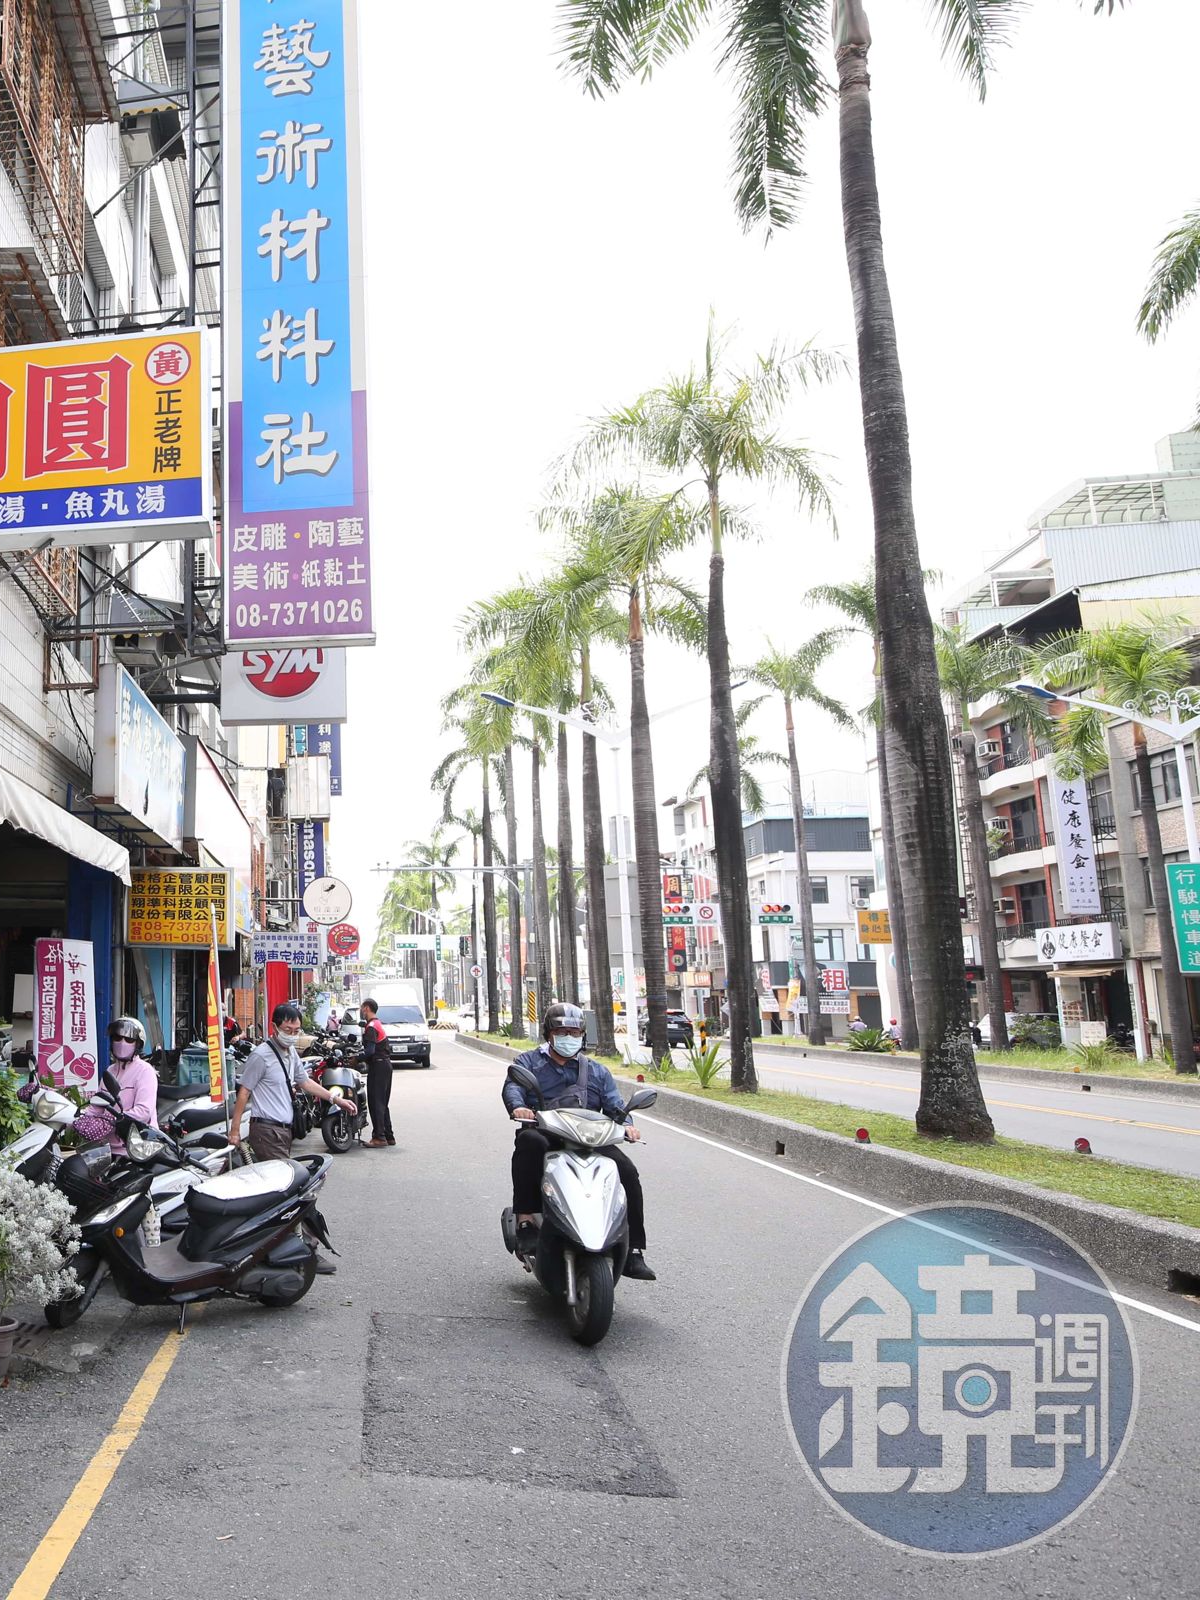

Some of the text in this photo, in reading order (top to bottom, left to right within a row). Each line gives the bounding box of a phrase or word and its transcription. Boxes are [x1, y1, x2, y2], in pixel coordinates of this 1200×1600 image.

[253, 0, 338, 485] 藝術材料社
[152, 350, 183, 379] 黃
[152, 389, 182, 474] 正老牌
[235, 598, 363, 628] 08-7371026
[243, 648, 324, 682] SYM
[1061, 788, 1089, 869] 健康餐盒
[131, 885, 225, 896] 股份有限公司
[131, 909, 225, 921] 股份有限公司
[1175, 869, 1200, 966] 行駛慢車道
[144, 932, 225, 943] 0911-01517
[1058, 929, 1103, 949] 健康餐盒
[254, 950, 319, 966] 機車定檢站
[823, 969, 847, 991] 租
